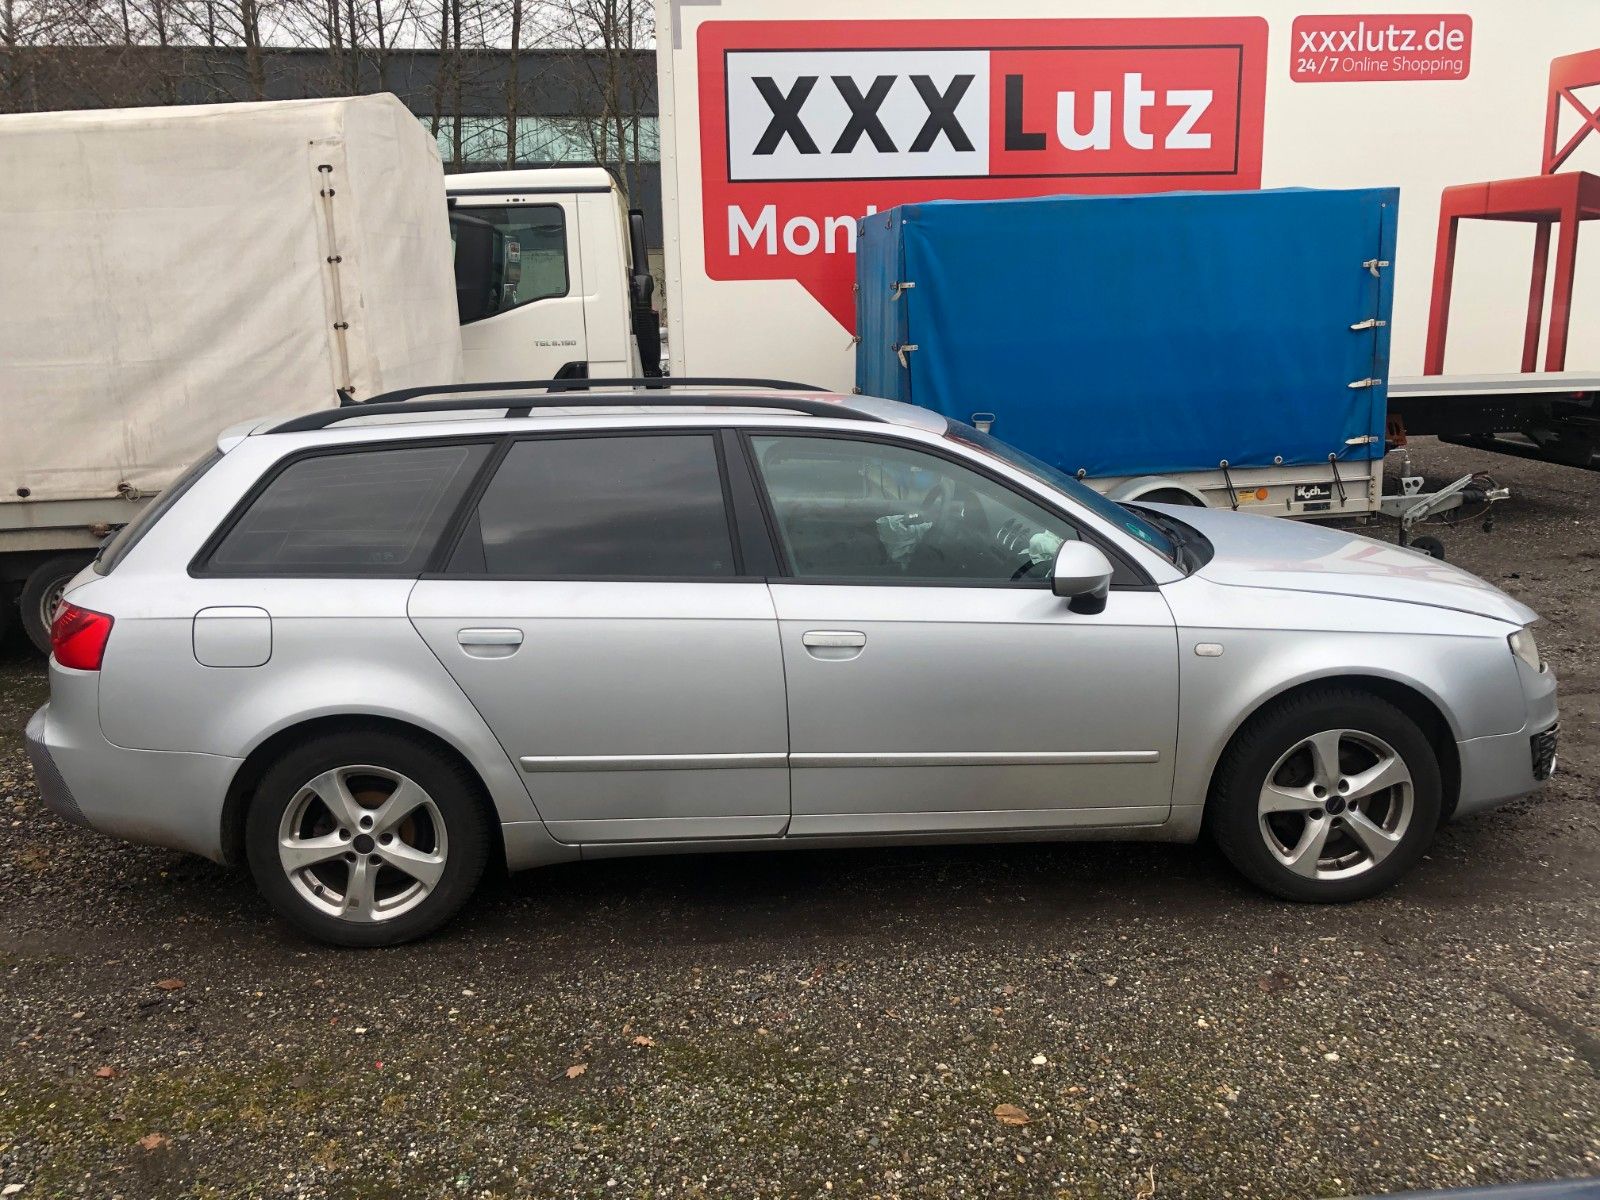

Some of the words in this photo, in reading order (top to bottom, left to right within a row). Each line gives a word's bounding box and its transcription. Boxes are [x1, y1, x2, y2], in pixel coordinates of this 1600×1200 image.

[1299, 21, 1465, 53] xxxlutz.de
[1297, 56, 1339, 74] 24/7
[1342, 57, 1388, 72] Online
[1392, 56, 1463, 75] Shopping
[727, 204, 877, 256] Mon
[1296, 485, 1326, 499] Koch
